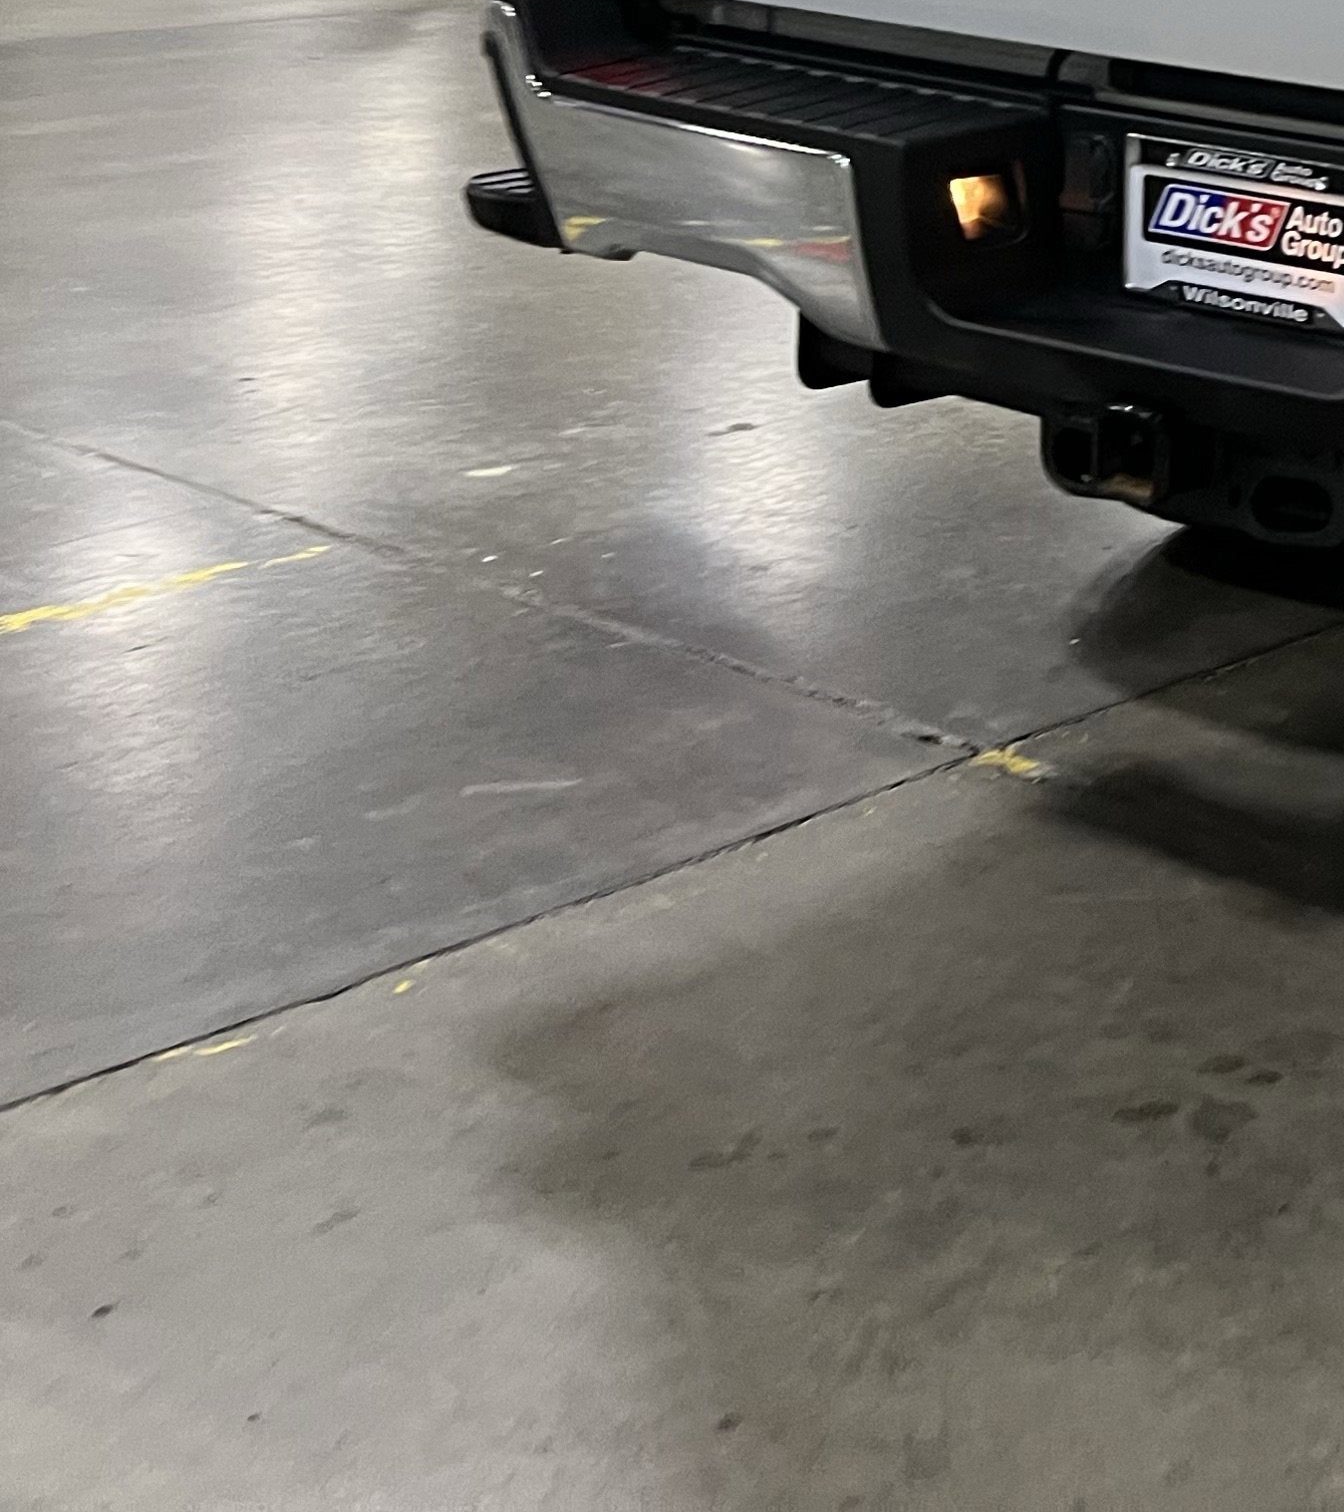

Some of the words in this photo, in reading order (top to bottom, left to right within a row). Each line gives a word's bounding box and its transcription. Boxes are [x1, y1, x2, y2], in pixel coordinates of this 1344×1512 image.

[1158, 190, 1275, 244] Dick's
[1285, 205, 1344, 239] Auto
[1160, 248, 1336, 294] dicksautogroup.com
[1181, 284, 1309, 323] Wilsonville
